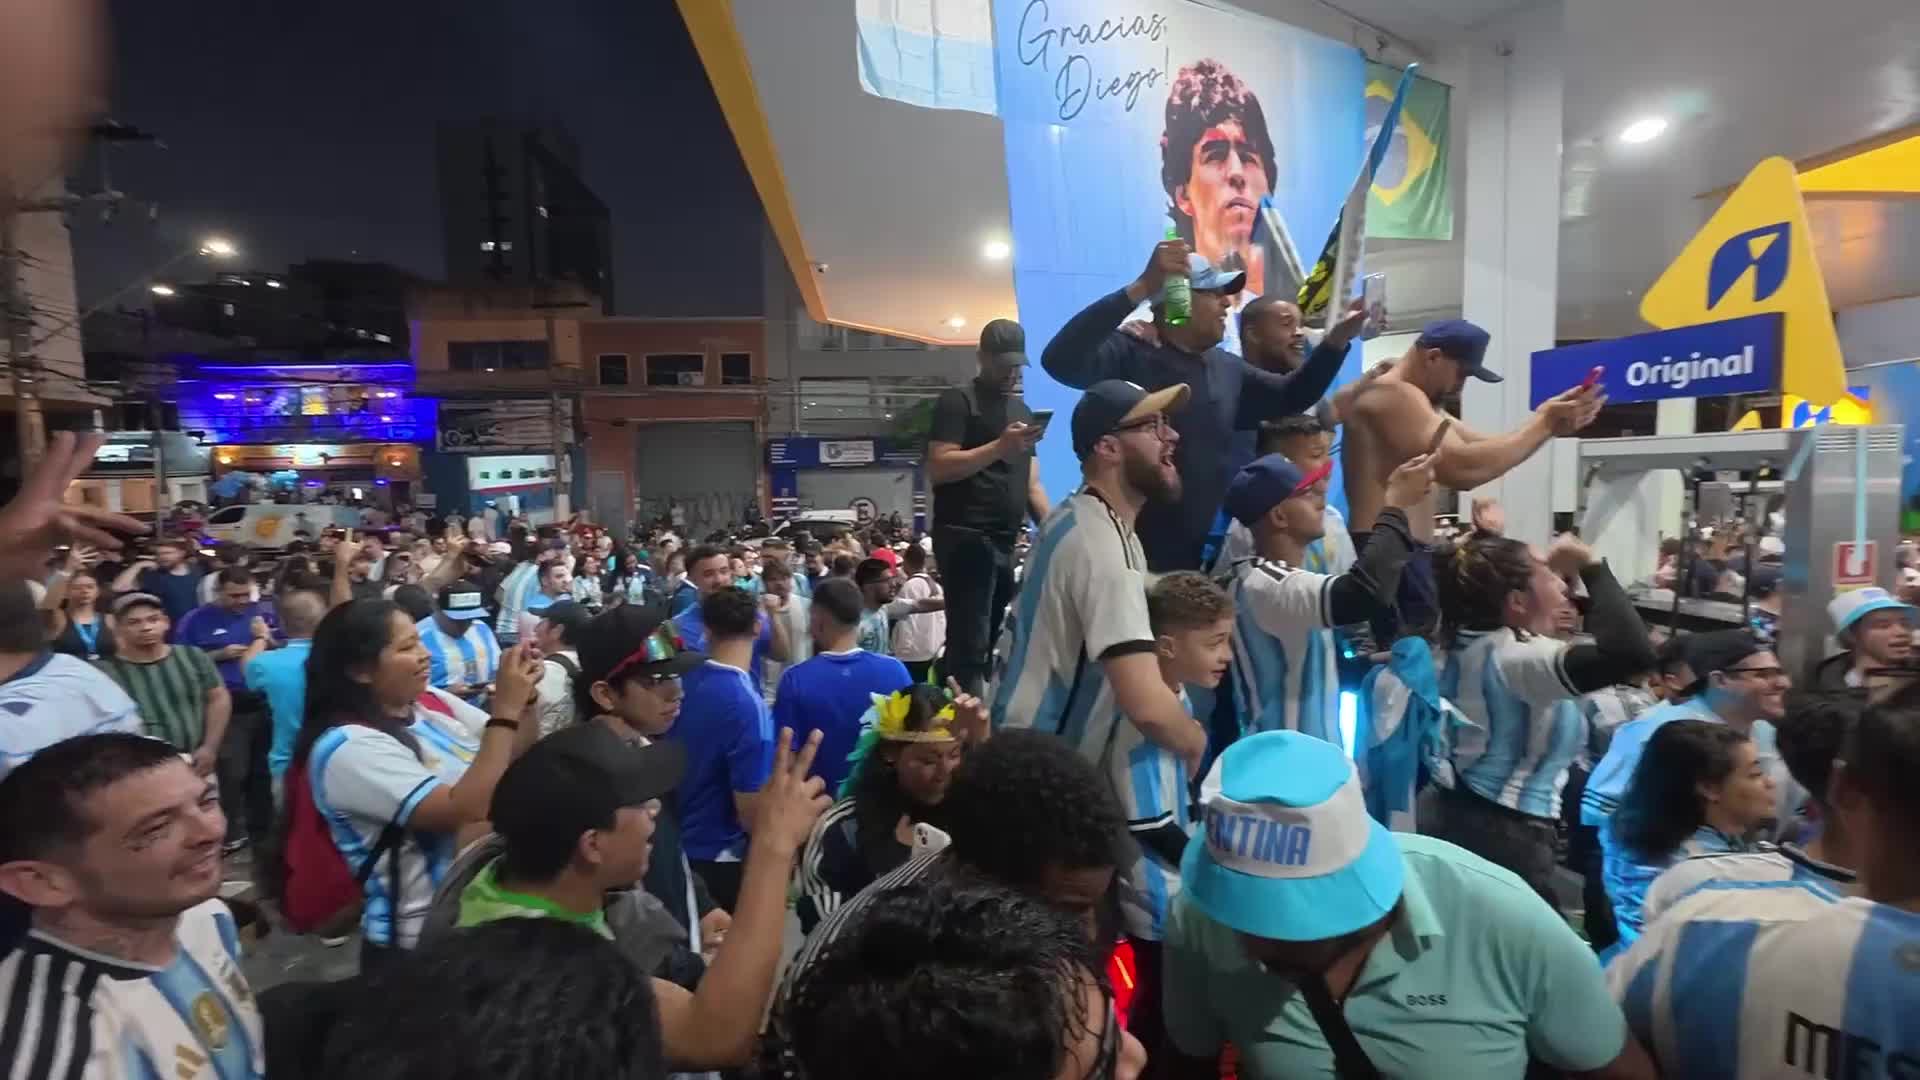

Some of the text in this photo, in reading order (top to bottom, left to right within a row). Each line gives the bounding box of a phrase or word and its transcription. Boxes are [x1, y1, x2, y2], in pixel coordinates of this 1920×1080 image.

[1055, 46, 1169, 120] Diego!
[1626, 345, 1755, 389] Original
[1406, 994, 1448, 1006] BOSS
